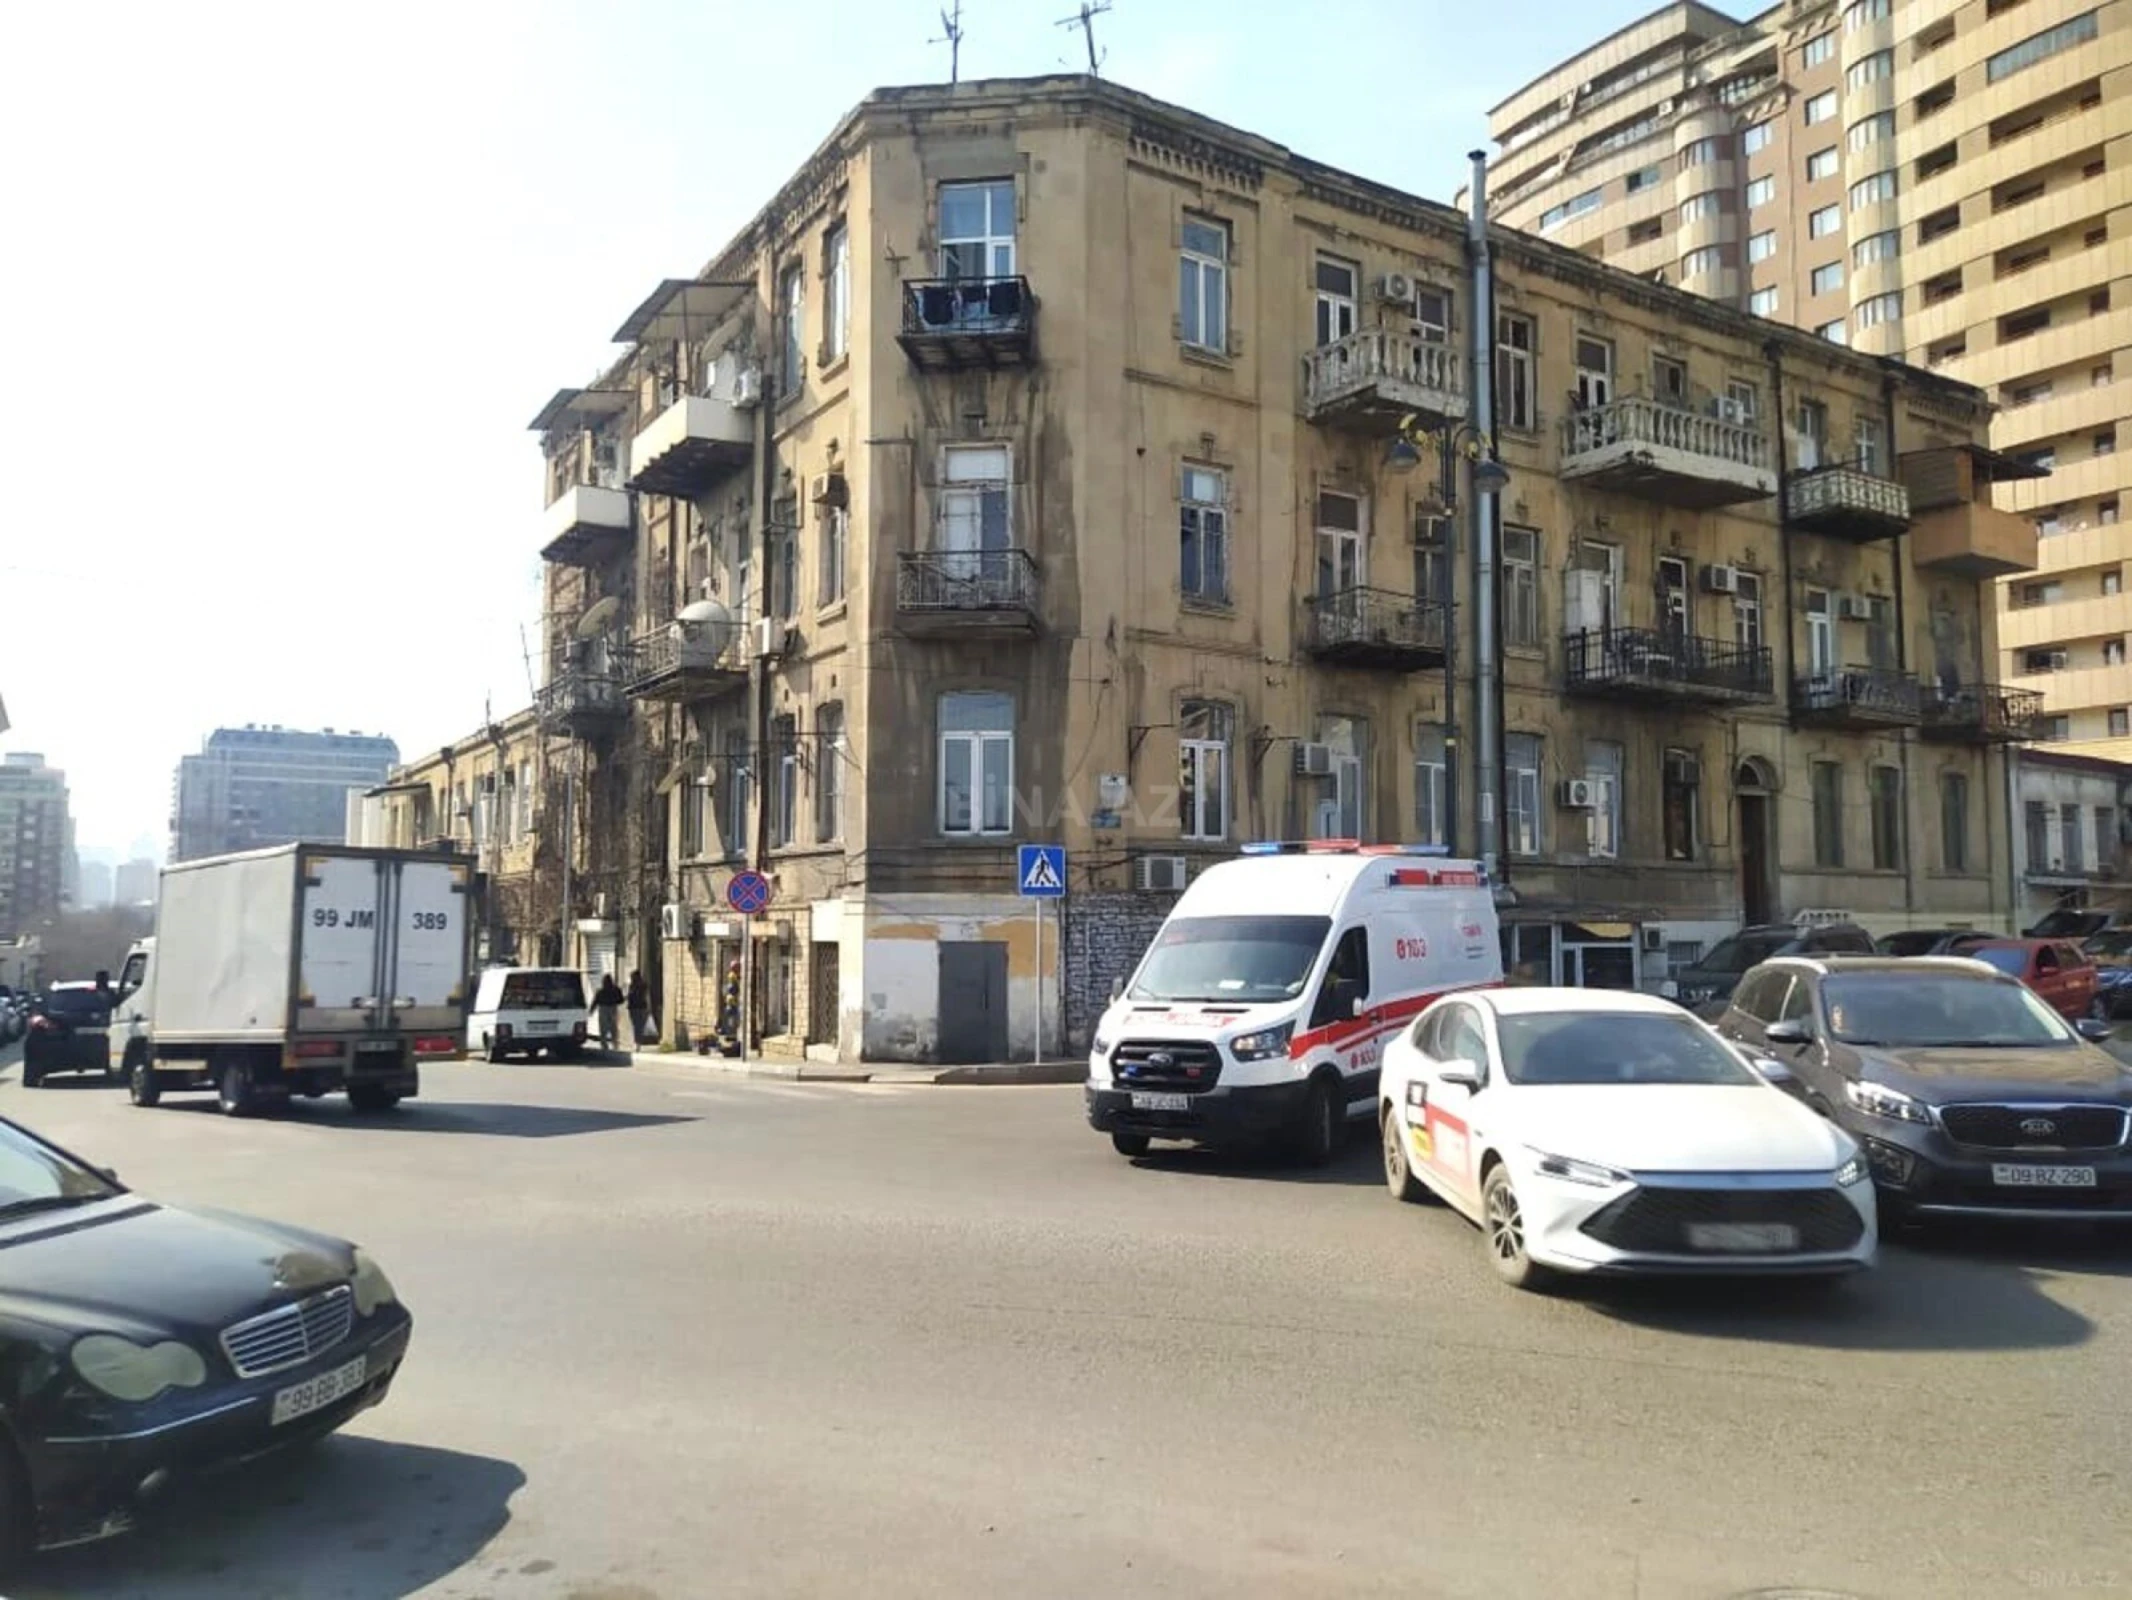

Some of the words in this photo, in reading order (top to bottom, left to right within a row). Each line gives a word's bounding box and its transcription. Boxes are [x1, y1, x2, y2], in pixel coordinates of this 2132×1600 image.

[313, 908, 339, 928] 99
[344, 910, 375, 930] JM
[412, 912, 448, 930] 389
